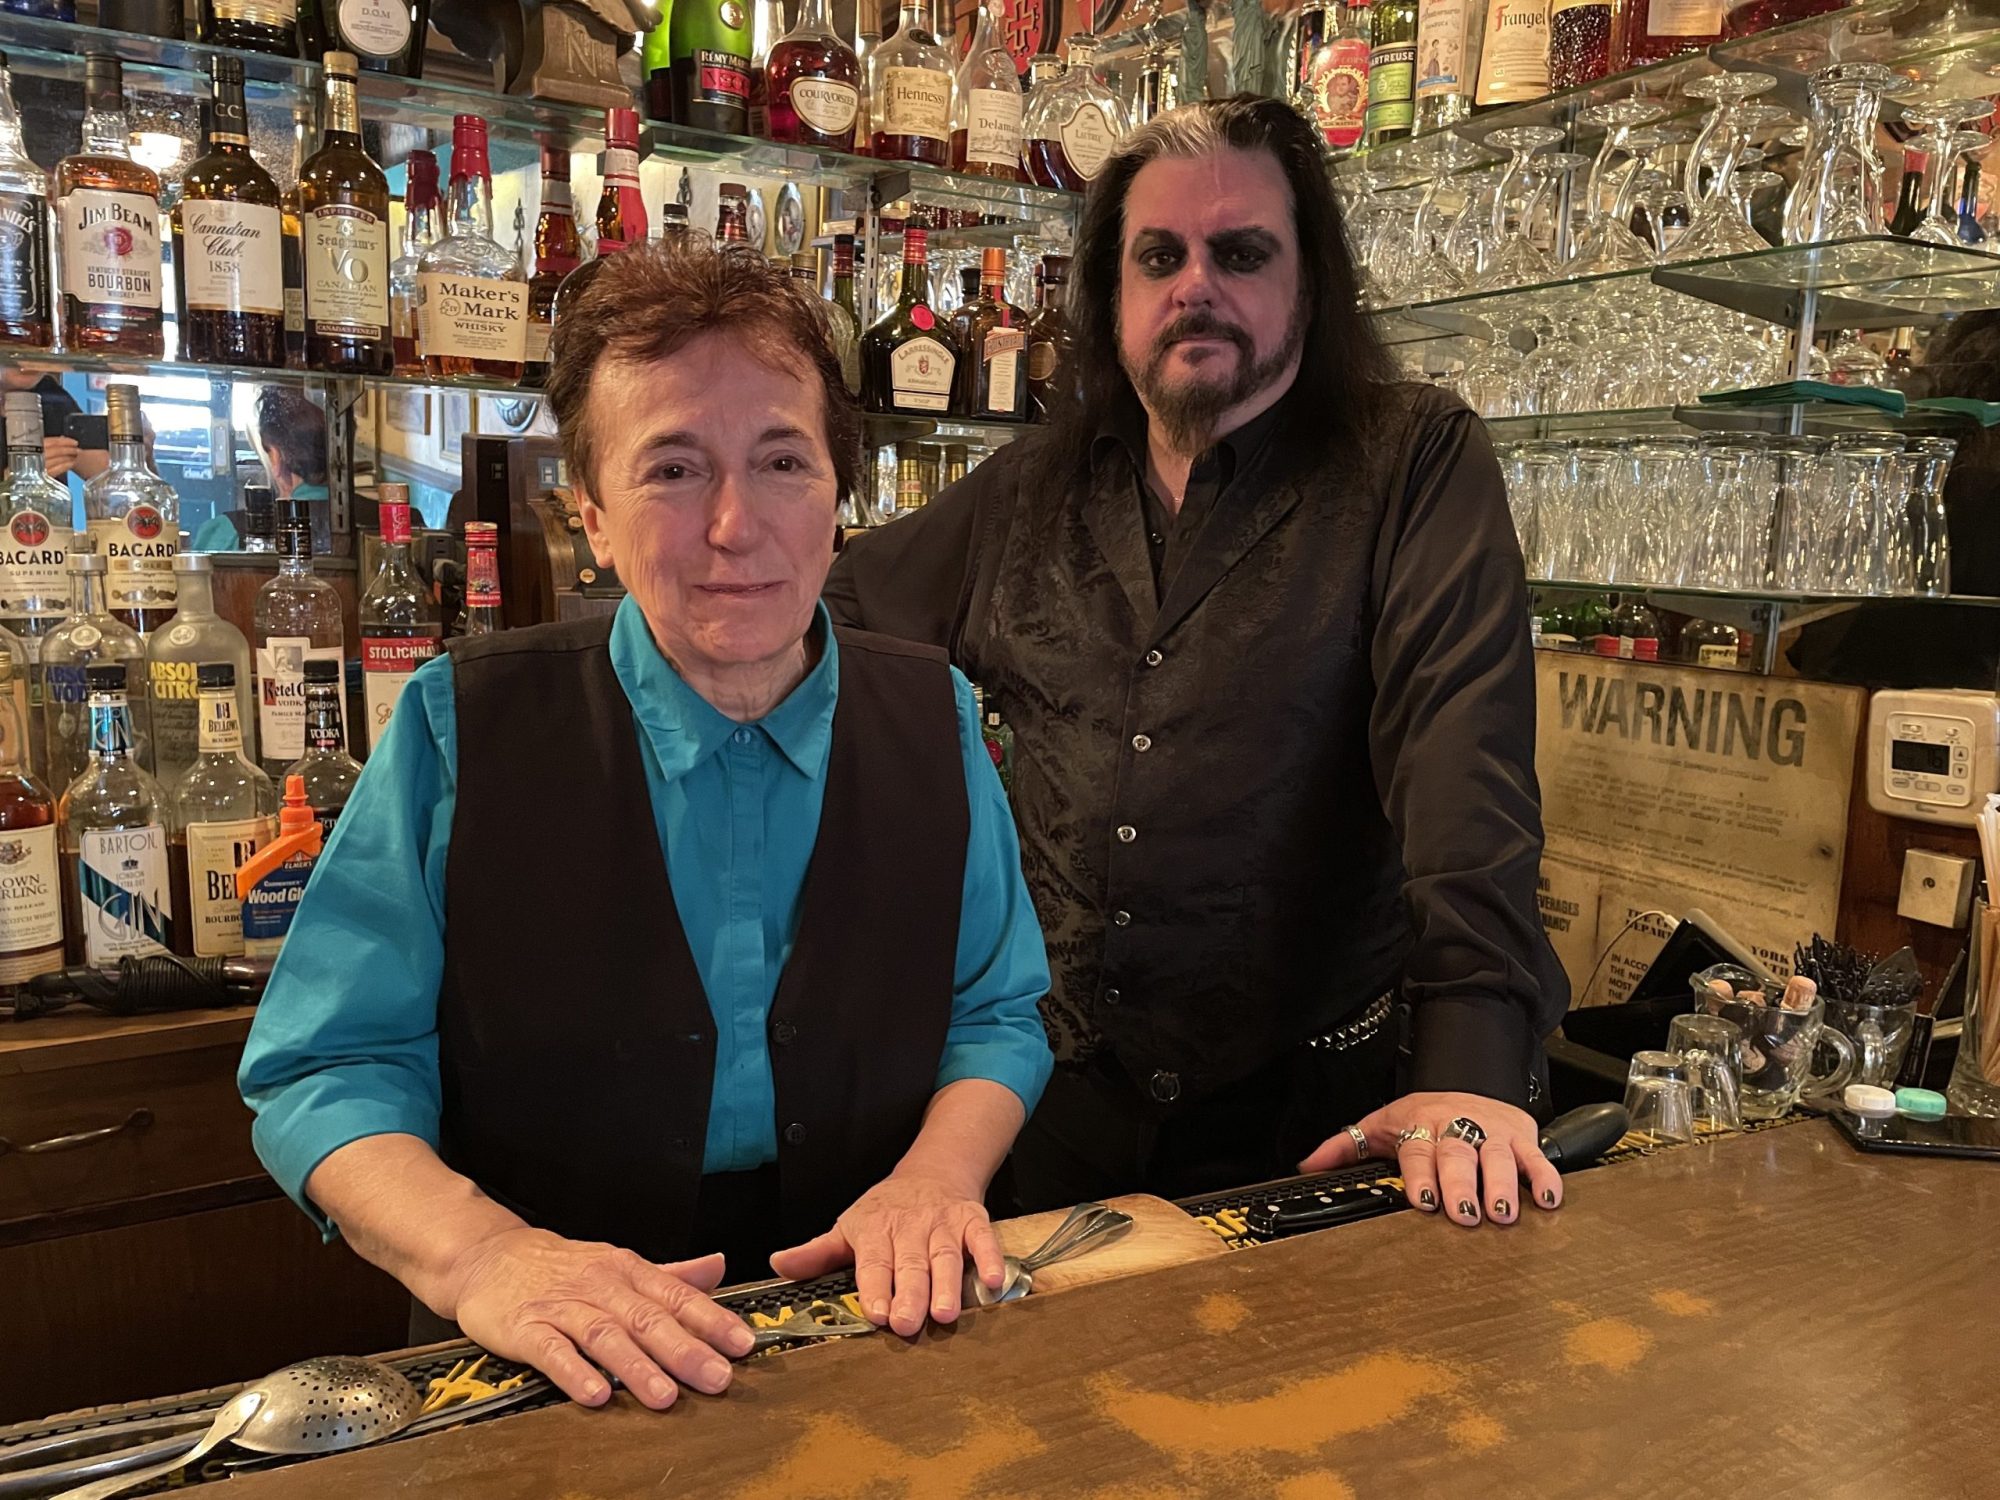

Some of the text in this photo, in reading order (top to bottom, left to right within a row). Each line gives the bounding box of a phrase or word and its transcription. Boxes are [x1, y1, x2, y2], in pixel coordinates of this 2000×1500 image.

[1495, 4, 1546, 31] Frangel
[701, 50, 727, 65] RÉMY
[1371, 51, 1415, 65] ARTREUSE
[799, 89, 855, 107] COURVOISIER
[2, 207, 36, 234] NIEL'S
[78, 202, 153, 236] JIM BEAM
[318, 208, 375, 224] IMPORTED
[189, 213, 261, 239] Canadian
[202, 234, 243, 257] Club
[317, 233, 379, 251] Seagram's
[122, 266, 151, 277] STRAIGHT
[208, 260, 240, 273] 1858
[88, 273, 152, 293] BOURBON
[438, 281, 521, 305] Maker's
[463, 302, 519, 321] Mark
[454, 321, 508, 333] WHISKY
[0, 547, 68, 566] BACARD
[9, 569, 60, 577] SUPERIOR
[369, 646, 440, 660] STOLICHNA
[151, 662, 198, 681] ABSOL
[155, 681, 199, 699] CITRO
[1559, 672, 1807, 768] WARNING
[310, 728, 340, 739] VODKA
[100, 831, 157, 855] BARTON
[0, 874, 40, 892] OWN
[117, 871, 144, 880] LONDON
[2, 883, 48, 900] RLING
[206, 870, 239, 901] BEL
[248, 889, 287, 904] Wood
[1537, 893, 1579, 917] VERAGES
[98, 887, 161, 940] GIN
[205, 913, 242, 924] BOURBO
[1611, 952, 1649, 972] IN ACCO
[1751, 943, 1789, 965] YORK
[1611, 964, 1626, 976] THE
[1608, 977, 1633, 992] MOST
[1608, 988, 1623, 1000] THE
